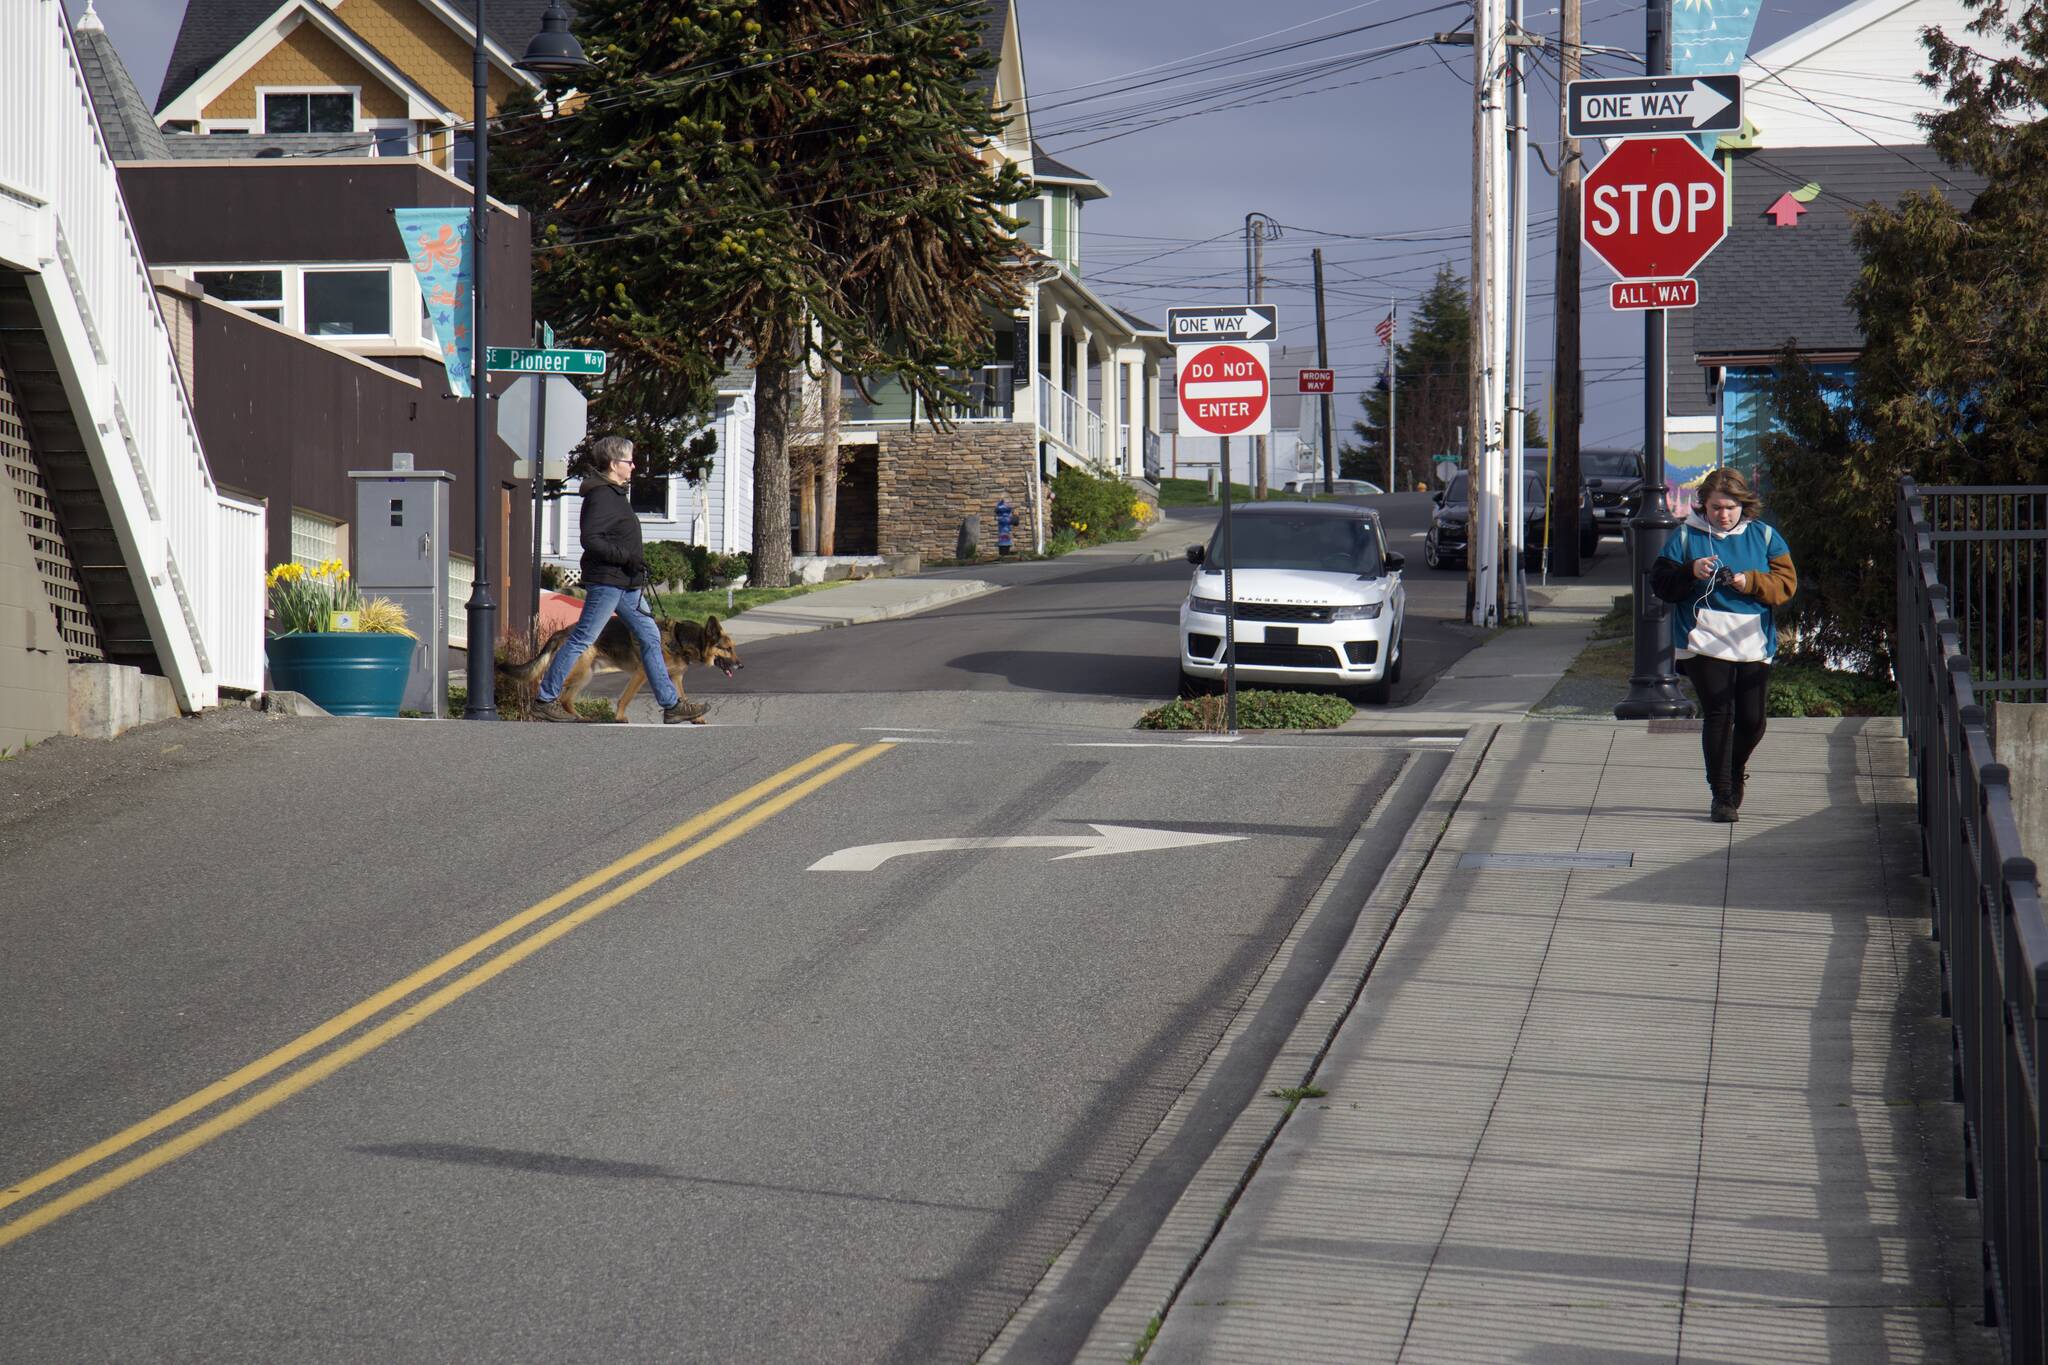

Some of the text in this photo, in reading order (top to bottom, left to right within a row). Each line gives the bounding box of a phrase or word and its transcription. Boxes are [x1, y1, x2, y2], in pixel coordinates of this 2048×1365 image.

[1587, 94, 1689, 119] ONE WAY
[1591, 182, 1717, 236] STOP
[1619, 285, 1690, 304] ALL WAY
[1179, 317, 1244, 332] ONE WAY
[510, 350, 570, 371] Pioneer
[584, 353, 603, 368] Way
[1192, 362, 1255, 378] DO NOT
[1302, 372, 1331, 381] WRONG
[1307, 382, 1325, 390] WAY
[1199, 402, 1250, 417] ENTER
